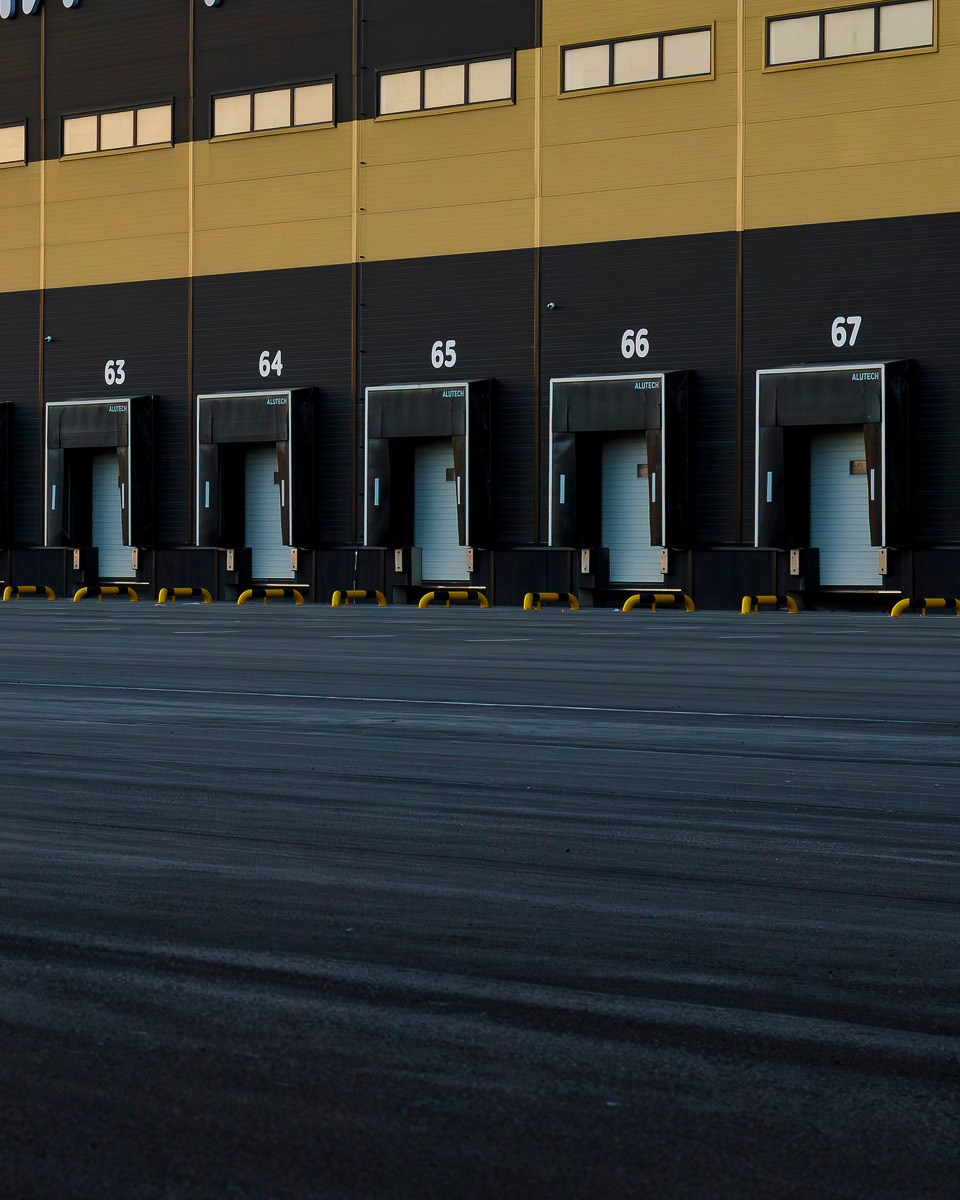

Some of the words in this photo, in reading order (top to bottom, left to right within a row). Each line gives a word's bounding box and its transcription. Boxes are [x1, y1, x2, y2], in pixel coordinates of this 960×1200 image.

[620, 328, 650, 359] 66
[830, 315, 863, 348] 67
[258, 350, 284, 378] 64
[431, 339, 457, 369] 65
[104, 359, 126, 386] 63
[634, 381, 660, 390] ALUTECH
[851, 372, 879, 381] ALUTECH
[442, 389, 464, 398] ALUTECH
